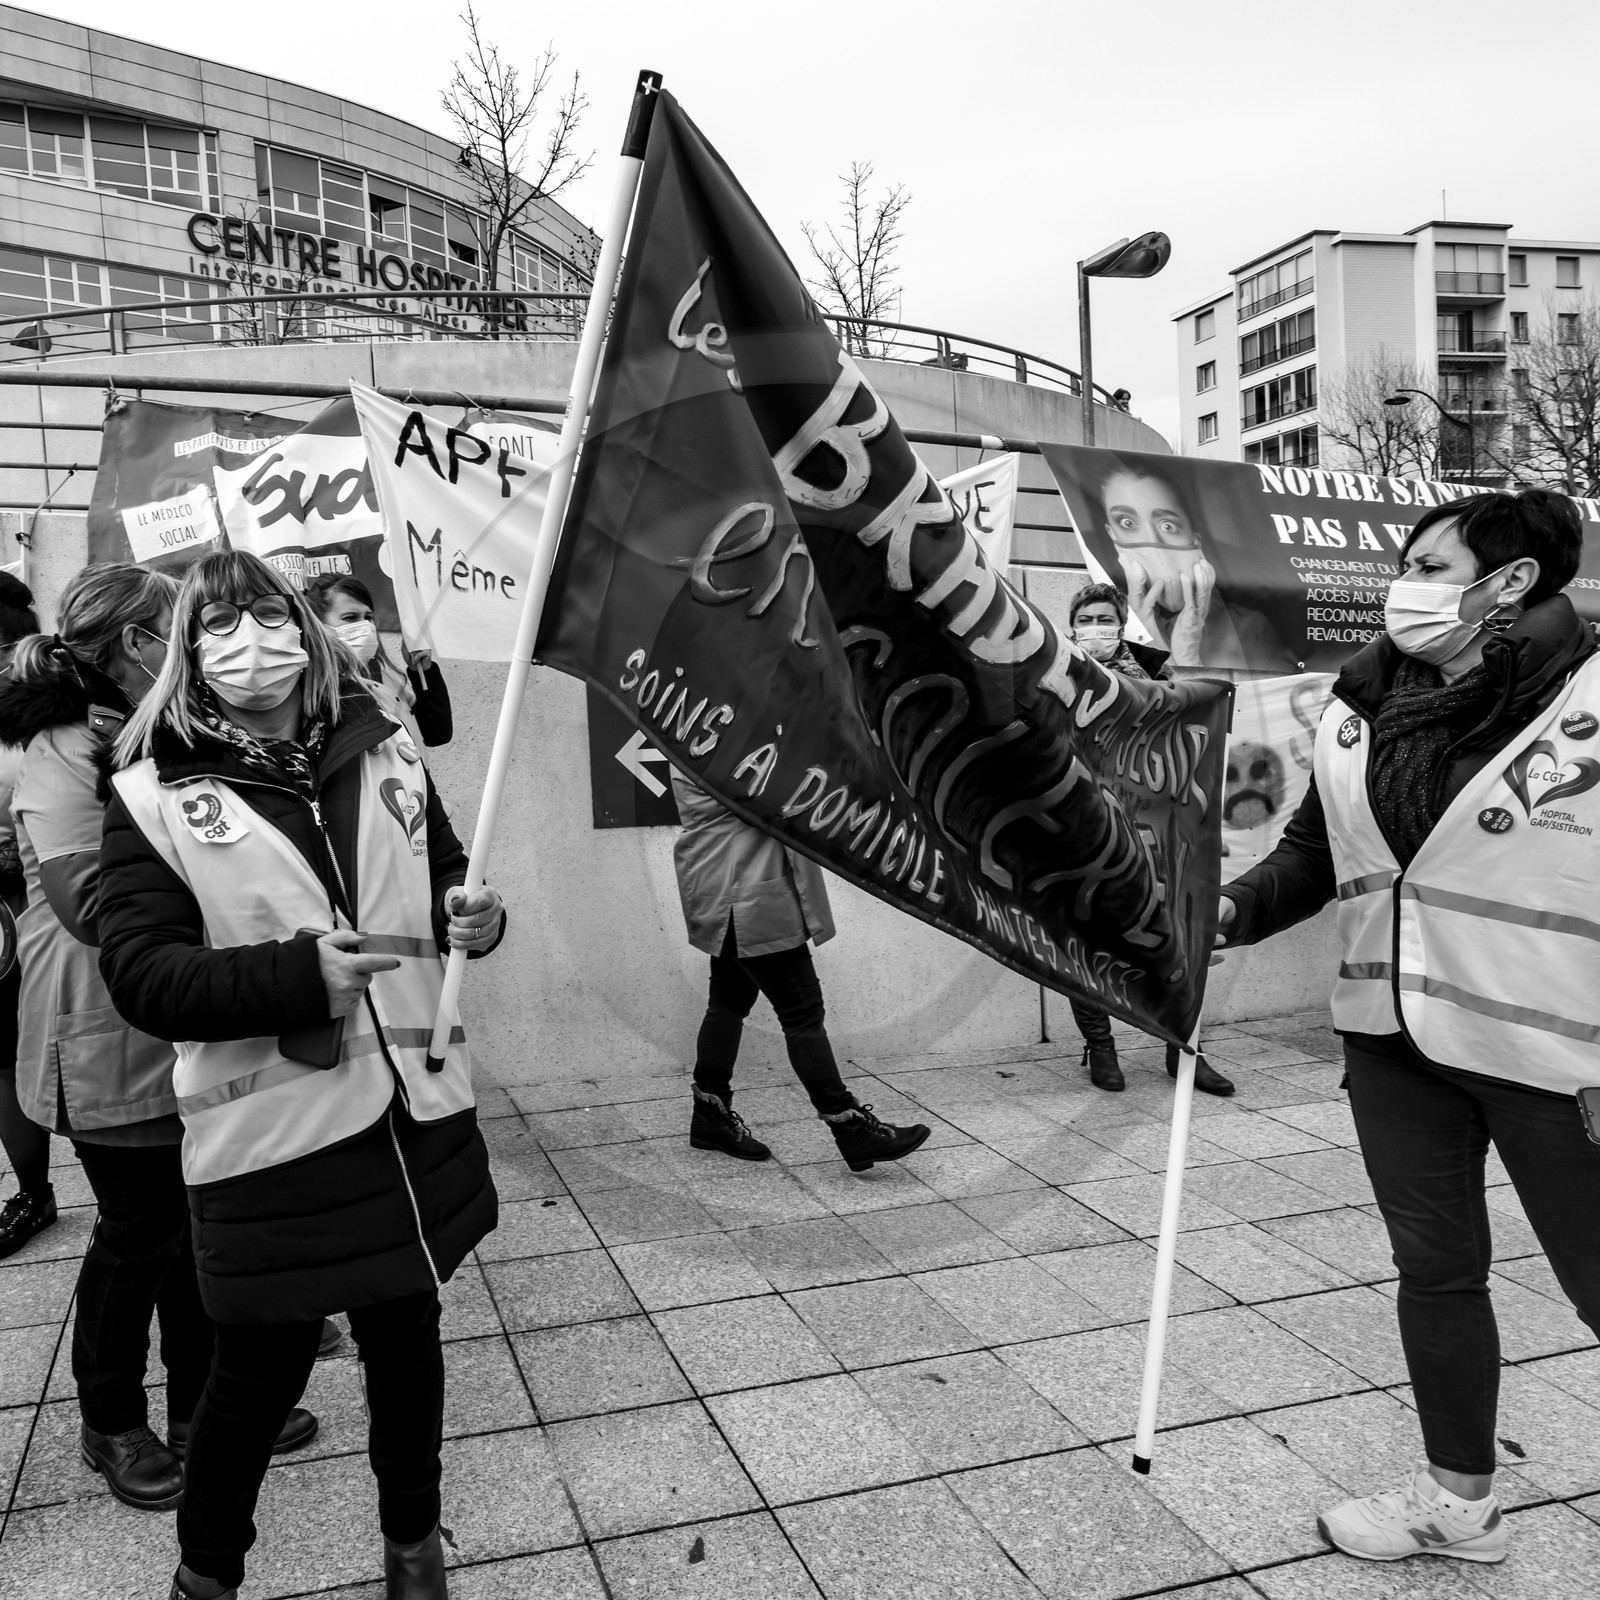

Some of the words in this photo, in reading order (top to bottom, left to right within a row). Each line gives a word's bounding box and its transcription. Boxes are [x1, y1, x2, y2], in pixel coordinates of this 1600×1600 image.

[187, 213, 342, 278] CENTRE
[357, 246, 529, 332] HOSPITALER
[237, 440, 248, 452] ET
[1254, 463, 1385, 503] NOTRE
[137, 513, 149, 526] LE
[151, 503, 194, 523] MEDICO
[159, 524, 199, 549] SOCIAL
[1270, 513, 1348, 548] PAS
[1358, 520, 1384, 551] A
[405, 518, 517, 601] Même
[1290, 556, 1375, 574] CHANGEMENT
[1306, 587, 1351, 604] ACCÈS
[1352, 591, 1379, 605] AUX
[1340, 719, 1360, 743] cgt
[1528, 767, 1540, 780] La
[1542, 770, 1566, 785] CGT
[1540, 808, 1576, 823] HOPITAL
[204, 820, 232, 840] cgt
[1529, 817, 1594, 837] GAP/SISTERON
